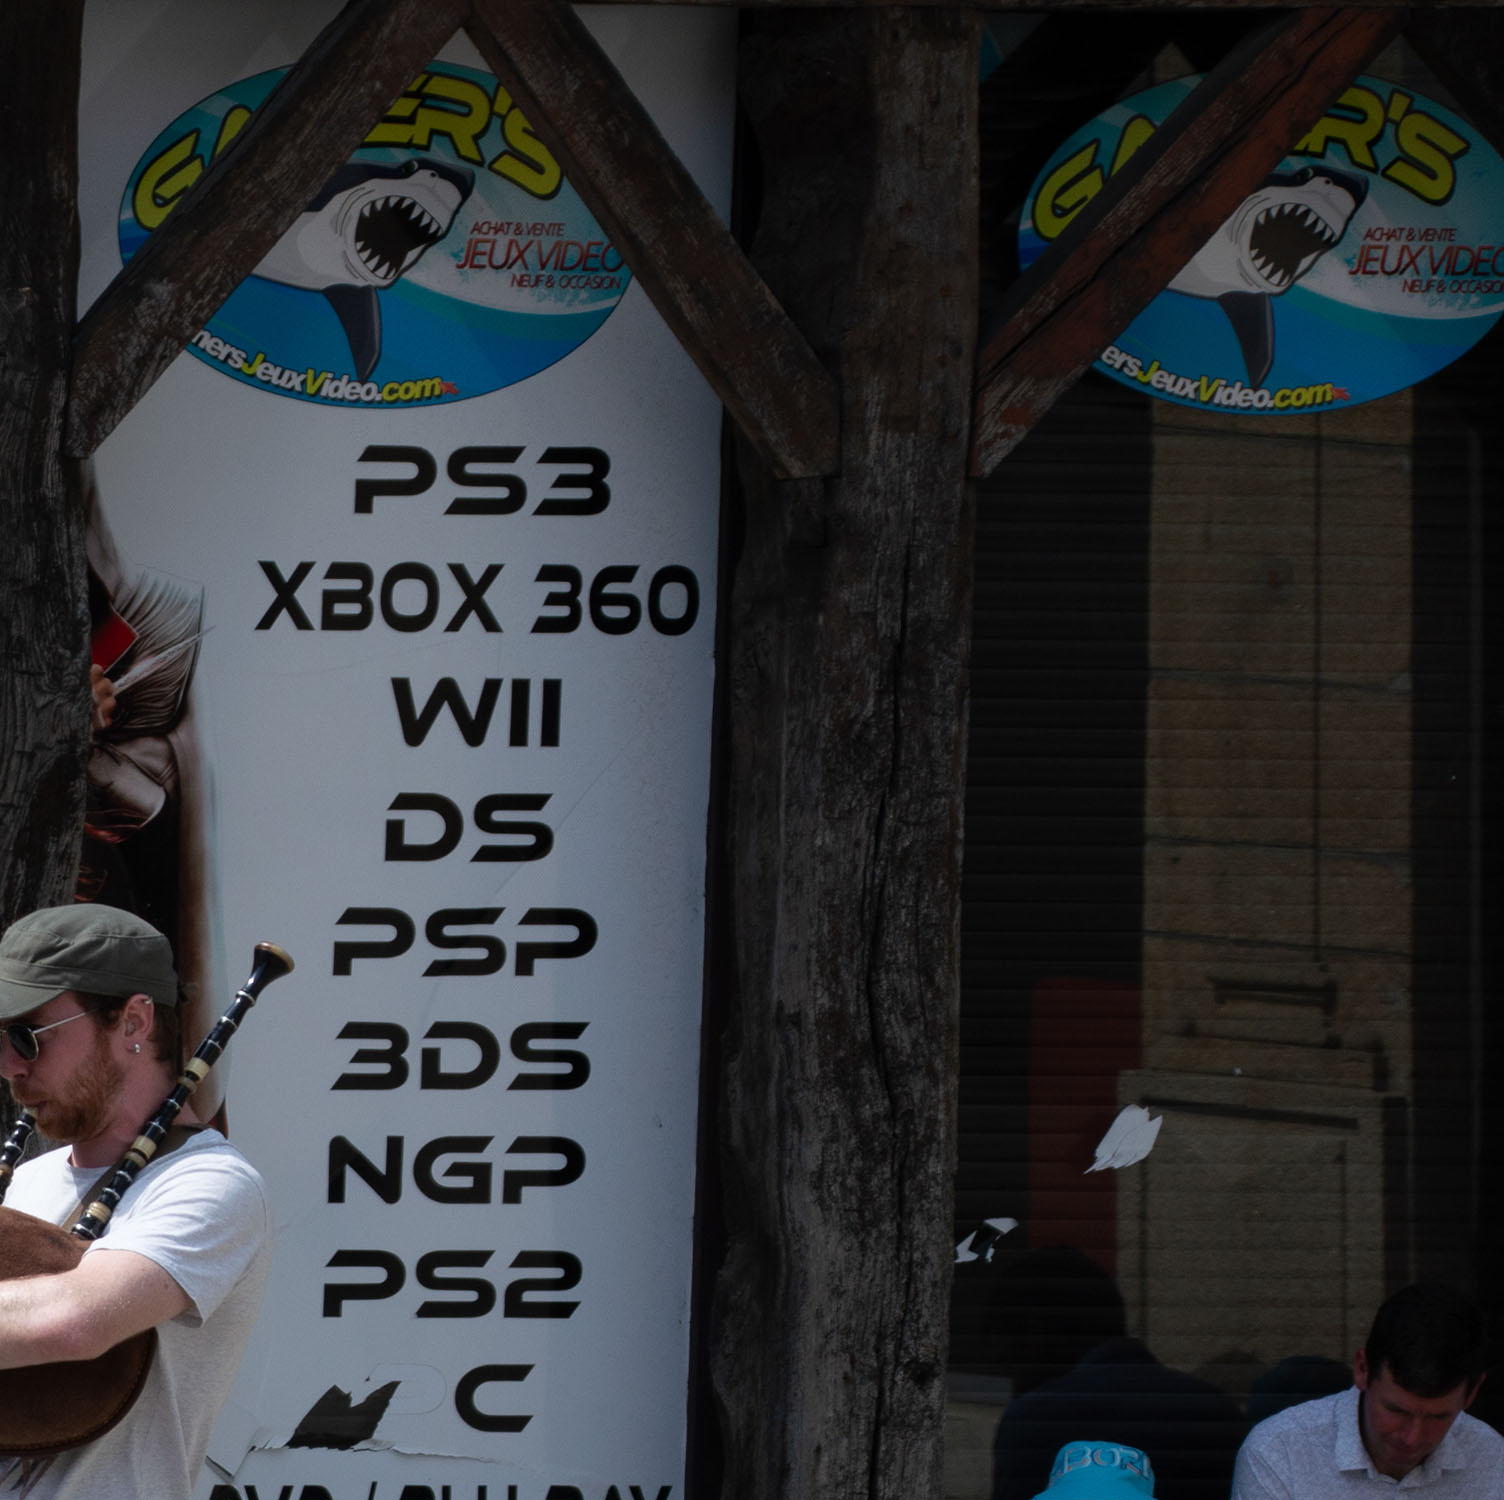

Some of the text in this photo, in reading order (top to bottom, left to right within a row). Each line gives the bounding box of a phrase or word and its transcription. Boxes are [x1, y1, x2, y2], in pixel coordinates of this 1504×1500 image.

[456, 238, 535, 271] JEUX
[471, 221, 566, 237] ACHAT & VENTE
[1348, 244, 1428, 276] JEUX
[1363, 228, 1407, 242] ACHAT
[1417, 228, 1457, 242] VENTE
[511, 275, 622, 290] NEUF & OCCASION
[354, 445, 611, 516] PS3
[255, 561, 701, 637] XBOX 360
[391, 677, 562, 748] WII
[384, 792, 554, 863] DS
[332, 907, 598, 977] PSP
[331, 1021, 591, 1091] 3DS
[327, 1135, 586, 1205] NGP
[322, 1249, 583, 1319] PS2
